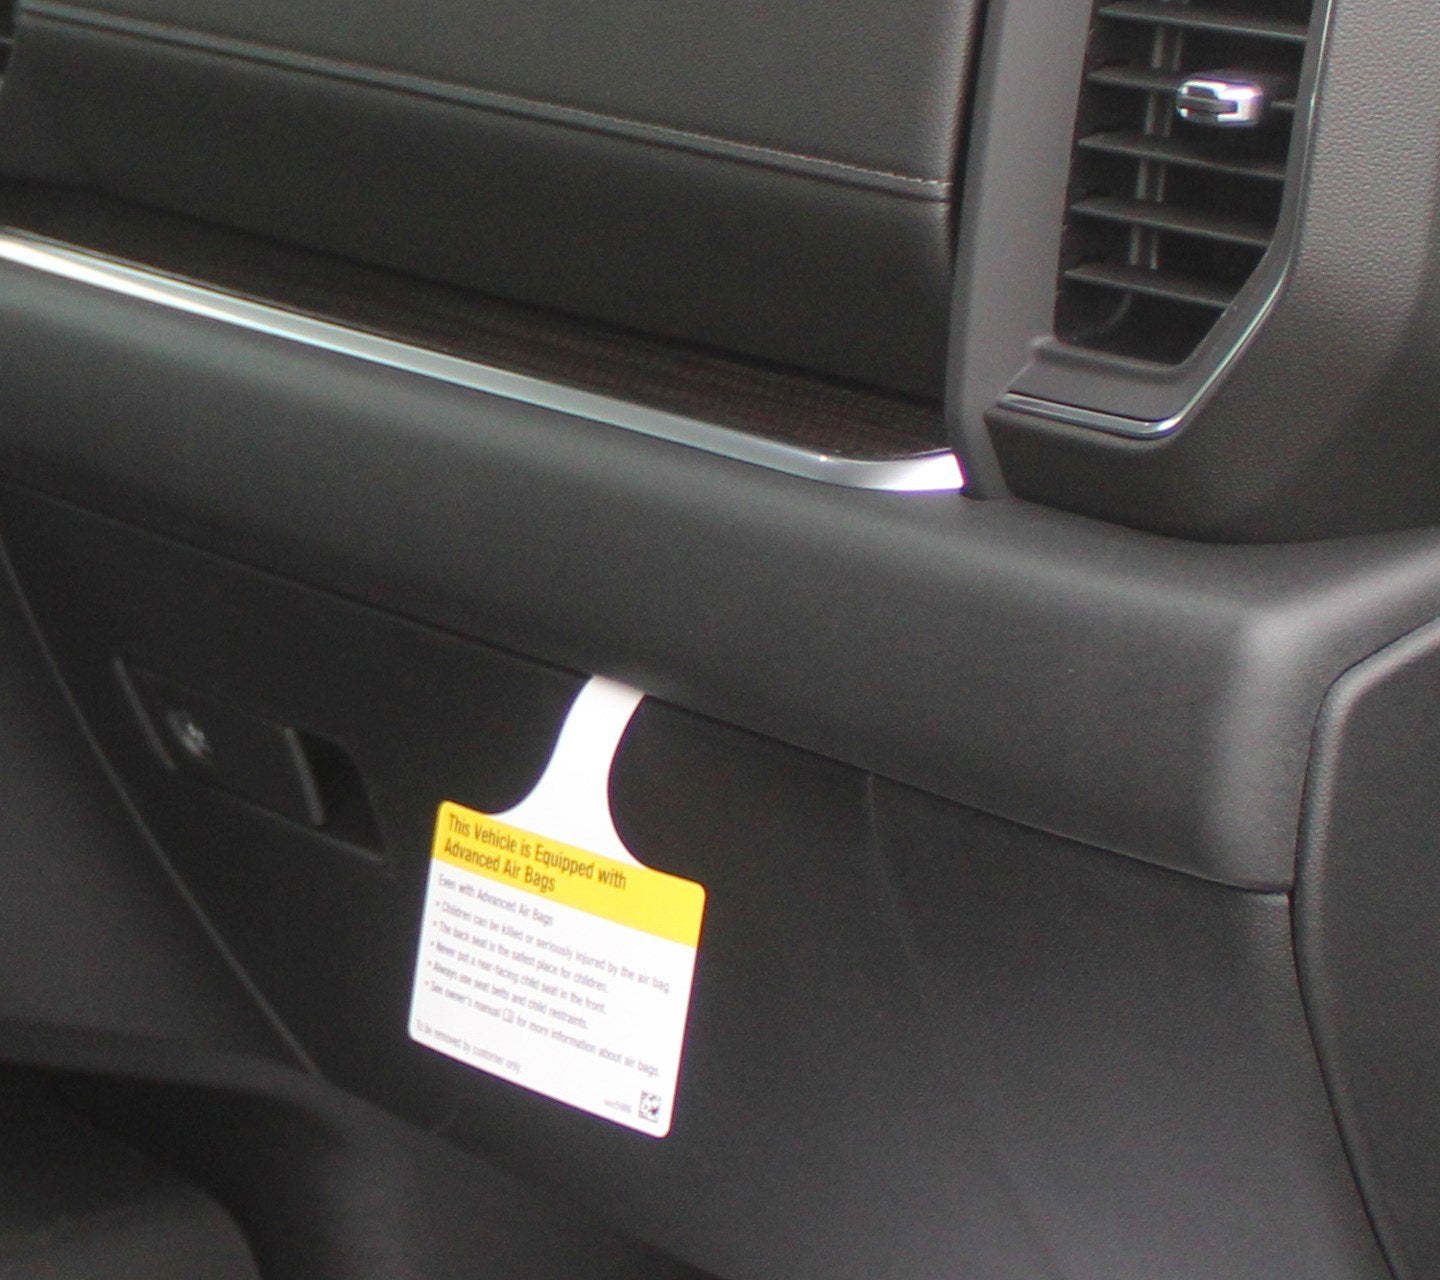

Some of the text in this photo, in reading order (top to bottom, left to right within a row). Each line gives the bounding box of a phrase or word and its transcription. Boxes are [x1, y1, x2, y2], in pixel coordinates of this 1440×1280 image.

[443, 837, 557, 893] Advanced Air Bags
[448, 813, 627, 891] This Vehicle is Equipped with
